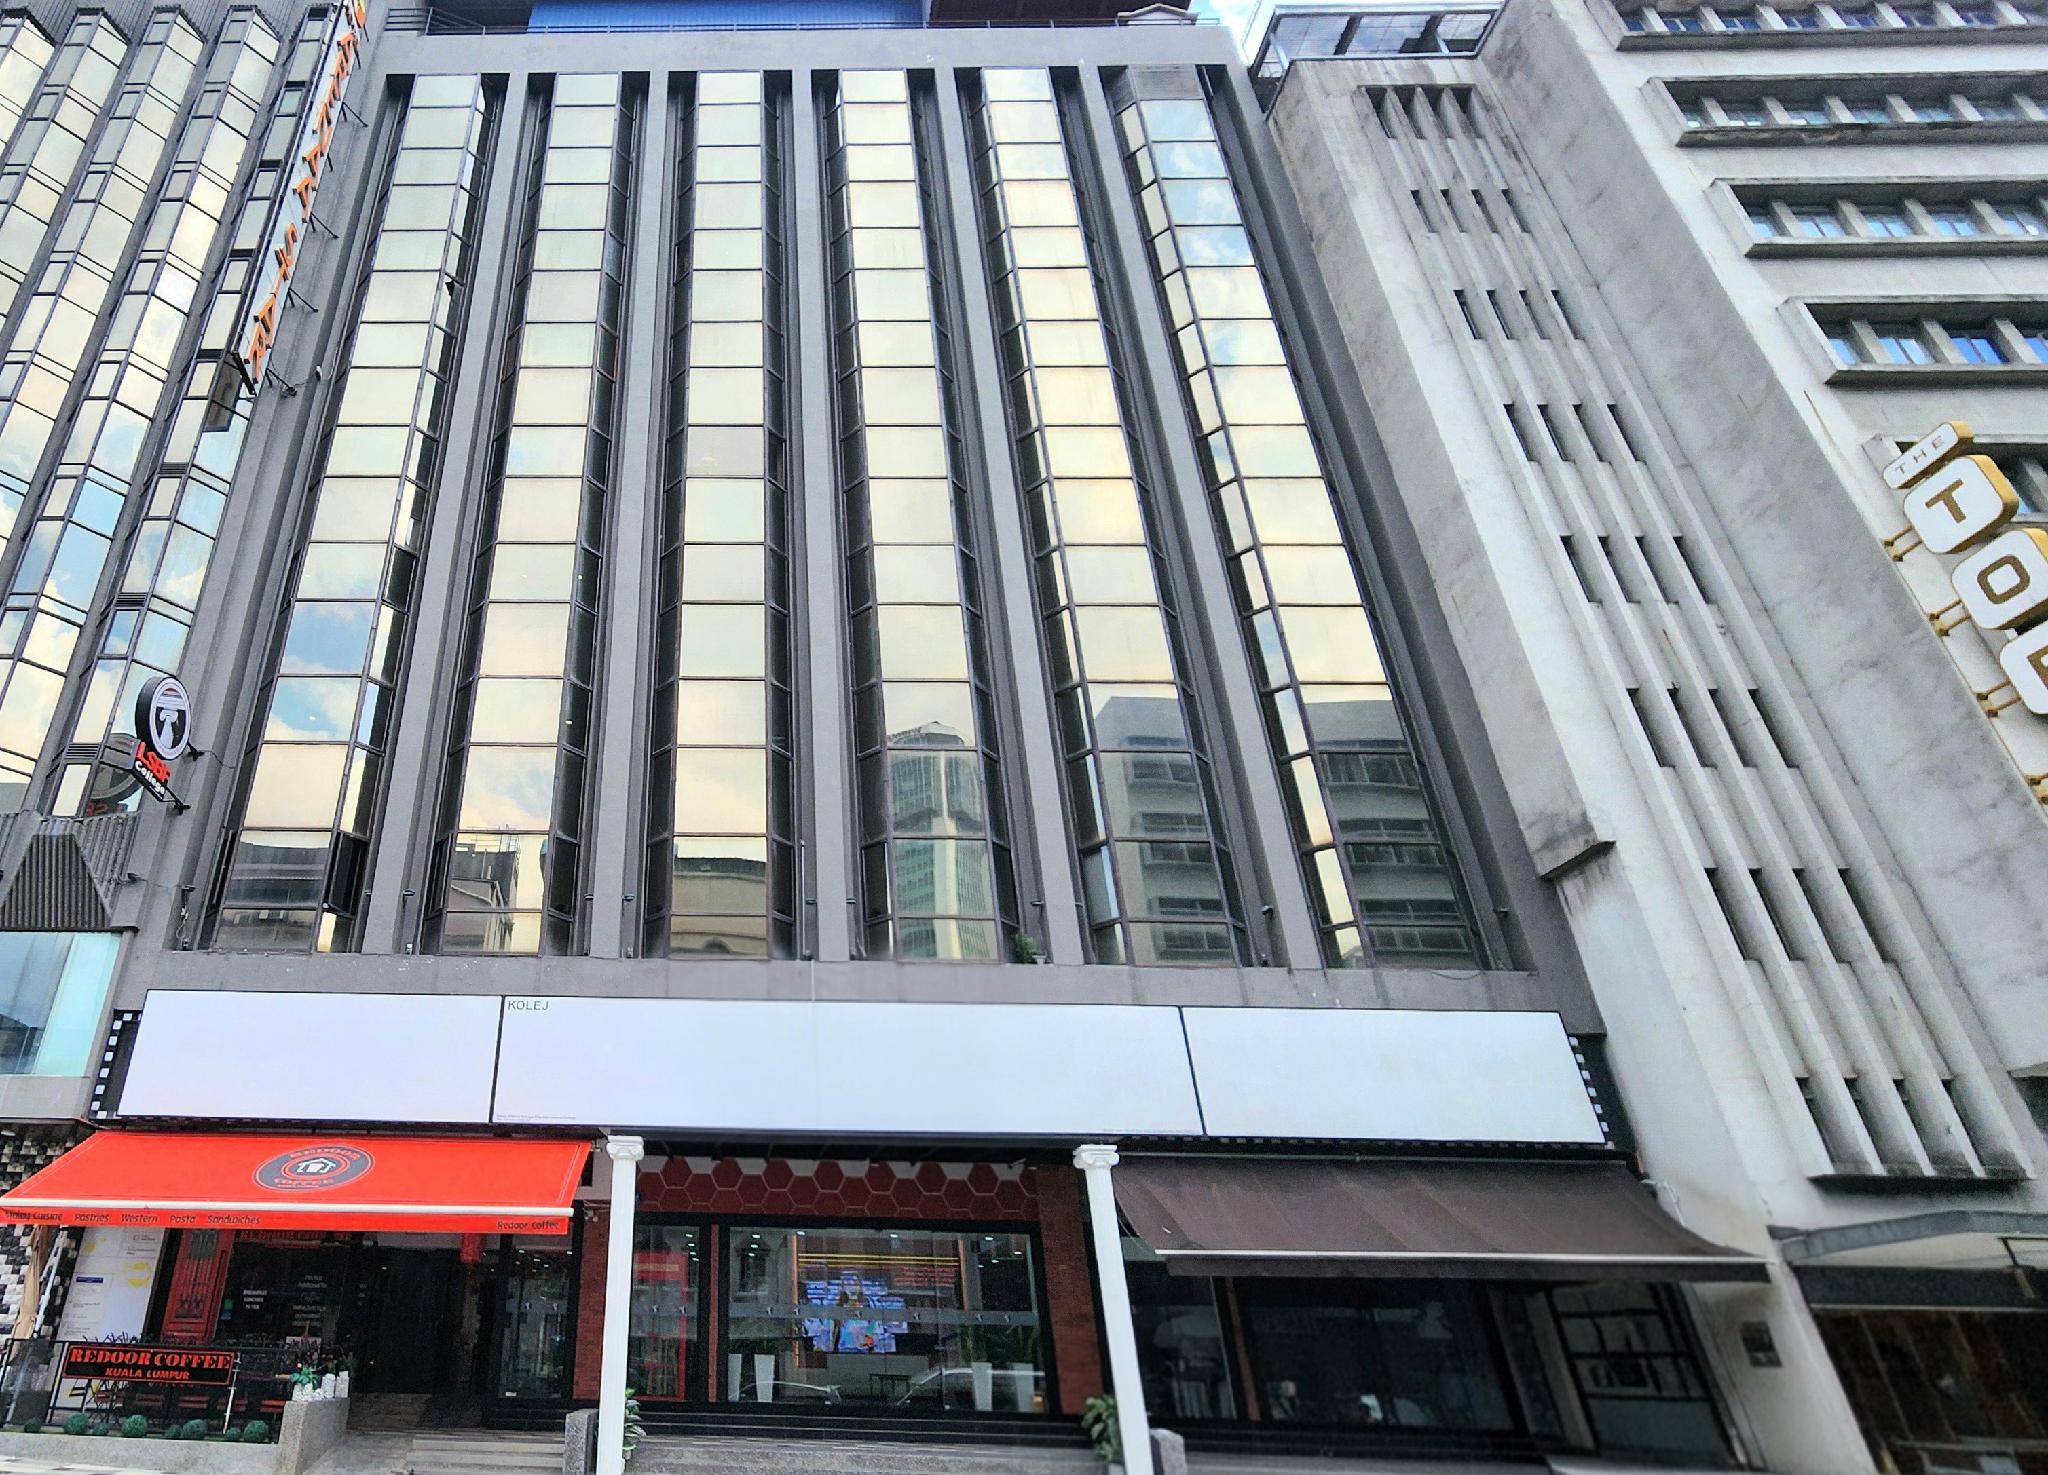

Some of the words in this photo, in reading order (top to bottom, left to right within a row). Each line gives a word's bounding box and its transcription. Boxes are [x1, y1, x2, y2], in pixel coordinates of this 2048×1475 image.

[1893, 435, 1946, 474] THE
[135, 761, 165, 794] College
[507, 1000, 549, 1011] KOLEJ
[74, 1213, 110, 1223] Pastries
[121, 1213, 158, 1223] Western
[170, 1214, 196, 1224] Pasta
[207, 1215, 261, 1225] Sandwiches
[69, 1348, 152, 1366] REDOOR
[154, 1353, 231, 1369] COFFEE
[105, 1367, 143, 1378] KUALA
[146, 1369, 190, 1380] LUMPUR
